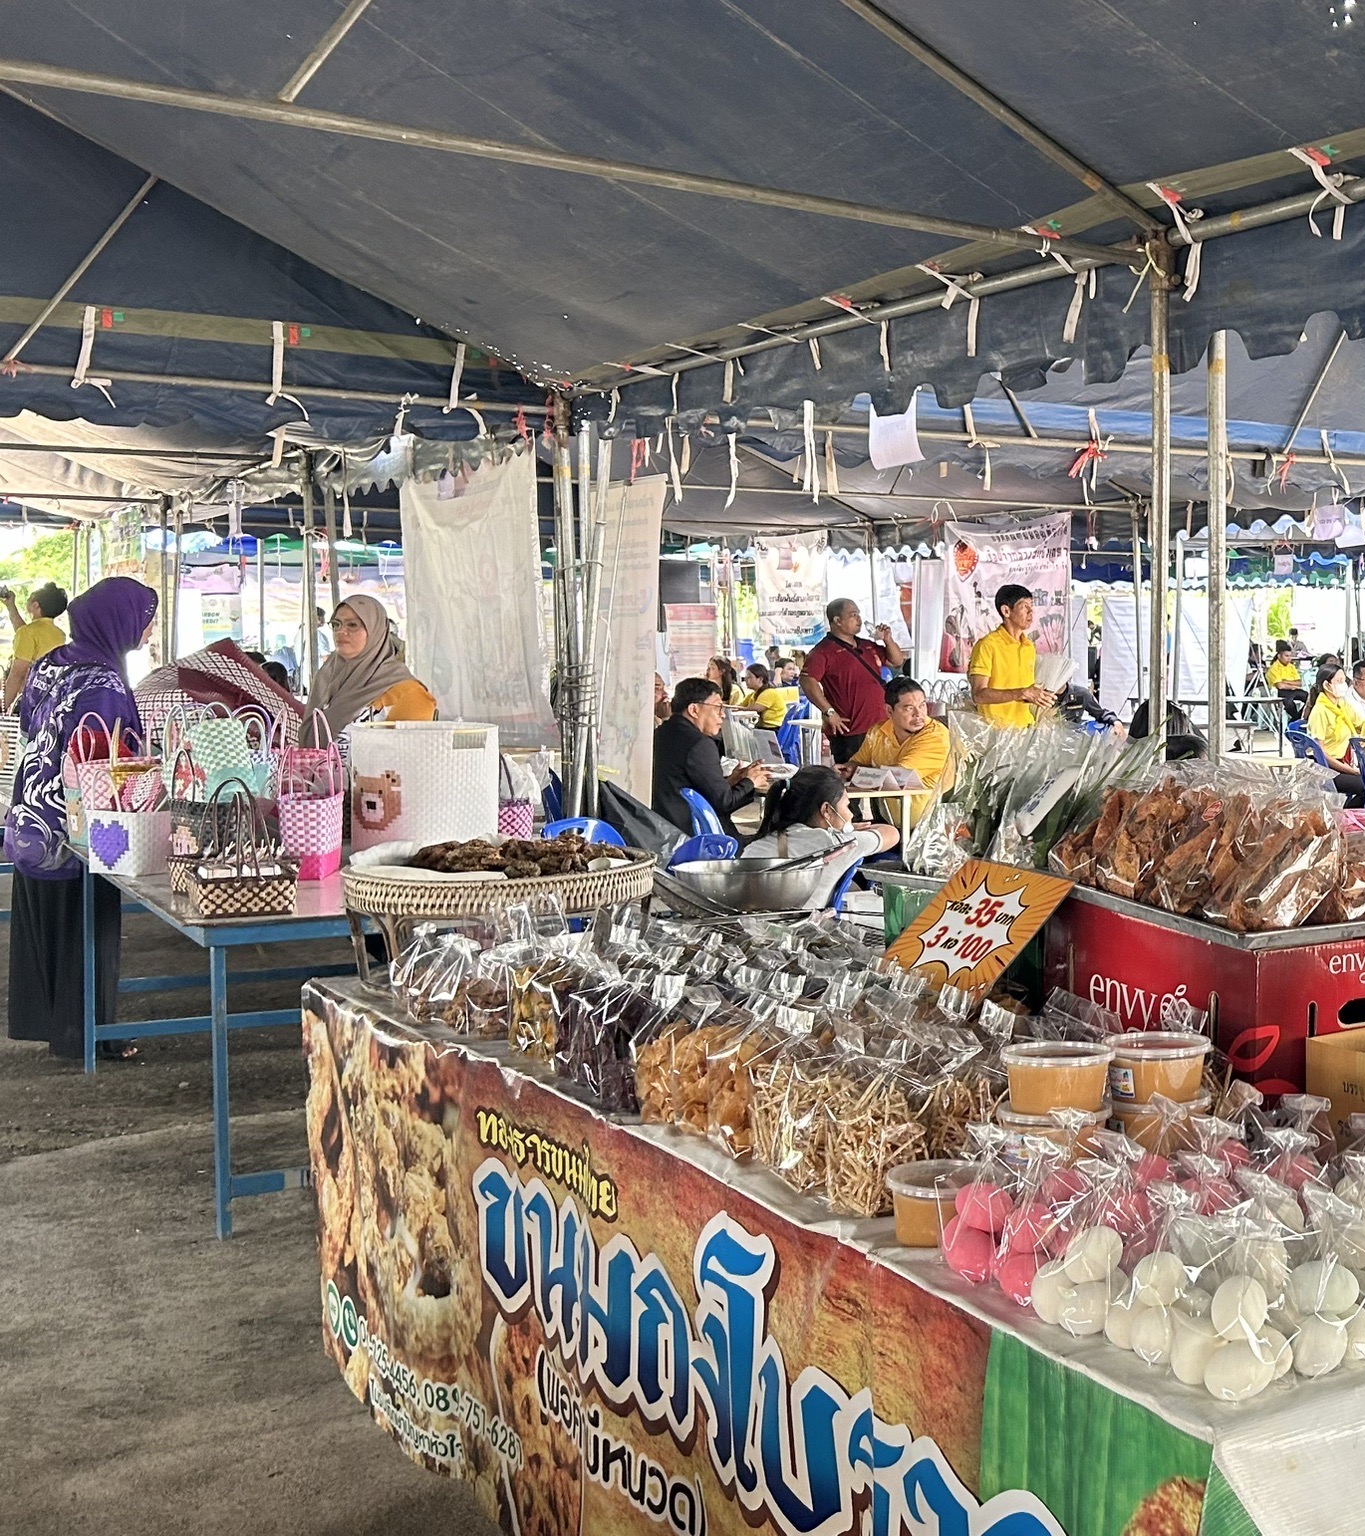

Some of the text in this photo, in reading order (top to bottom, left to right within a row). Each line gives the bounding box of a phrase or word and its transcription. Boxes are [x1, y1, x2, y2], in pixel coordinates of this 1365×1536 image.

[965, 898, 1005, 928] 35
[926, 926, 949, 949] 3
[954, 932, 993, 963] 100
[1089, 973, 1159, 1034] envy
